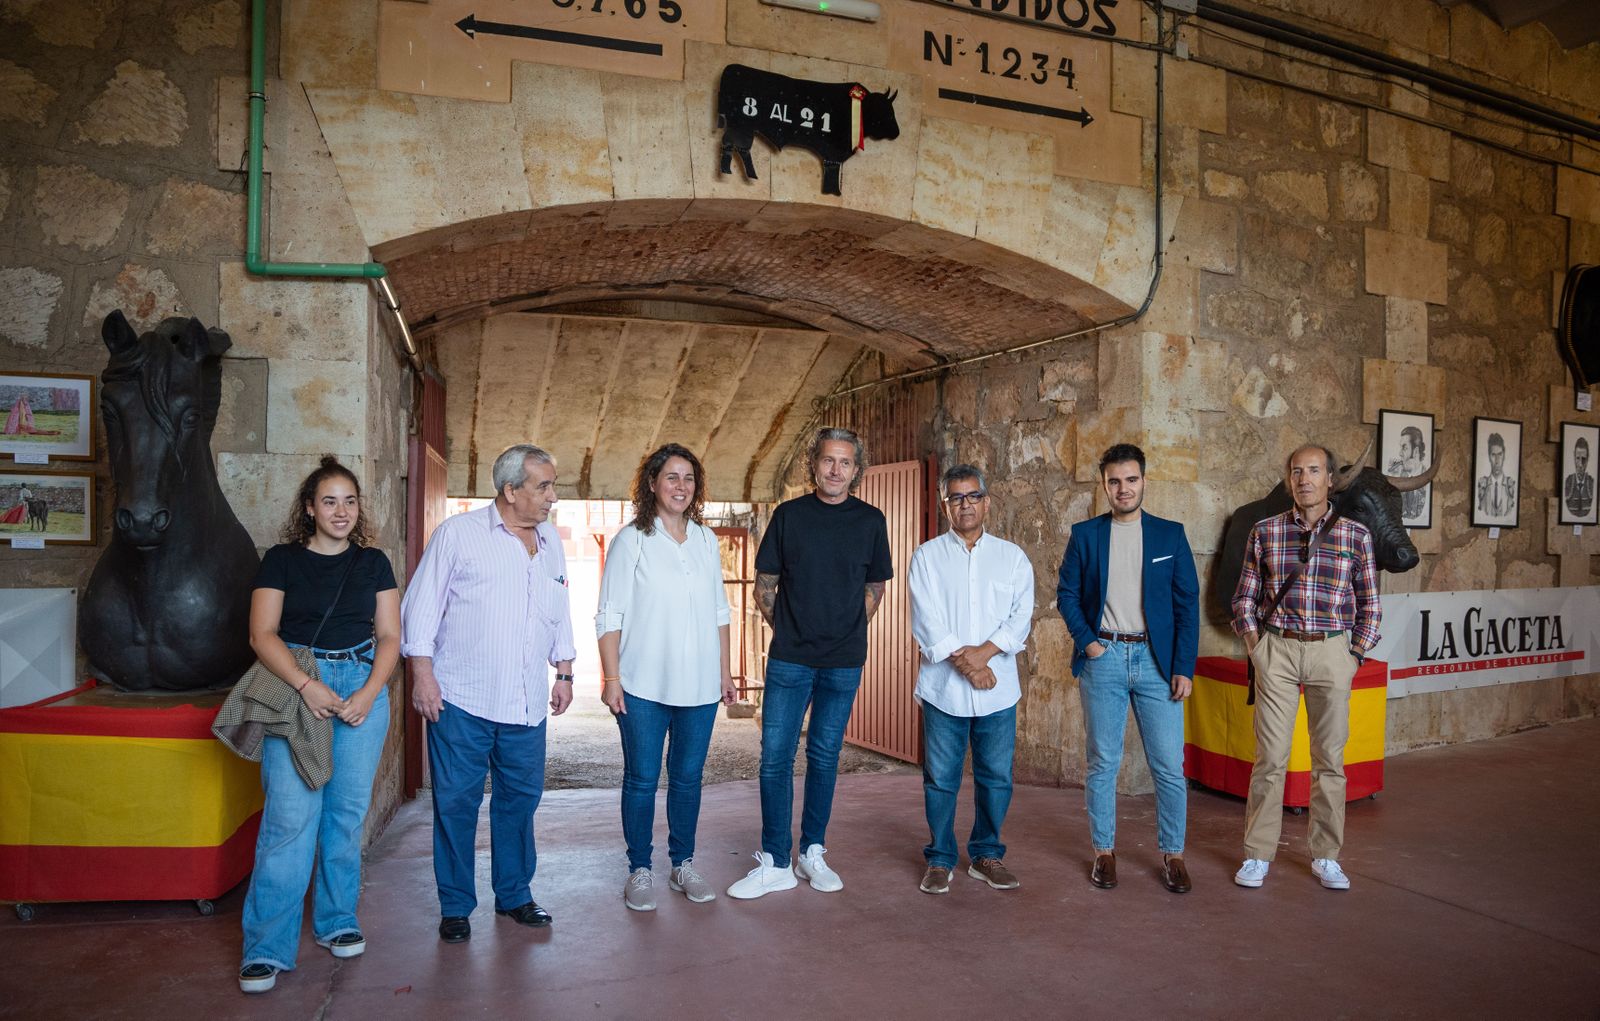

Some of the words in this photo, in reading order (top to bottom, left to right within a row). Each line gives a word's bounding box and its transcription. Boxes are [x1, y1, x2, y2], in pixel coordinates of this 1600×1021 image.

[946, 0, 1118, 36] DOS
[742, 97, 758, 117] 8
[769, 103, 793, 124] AL
[800, 107, 832, 133] 21
[1417, 661, 1477, 675] REGIONAL
[1485, 660, 1498, 669] DE
[1507, 654, 1565, 667] SALAMANCA
